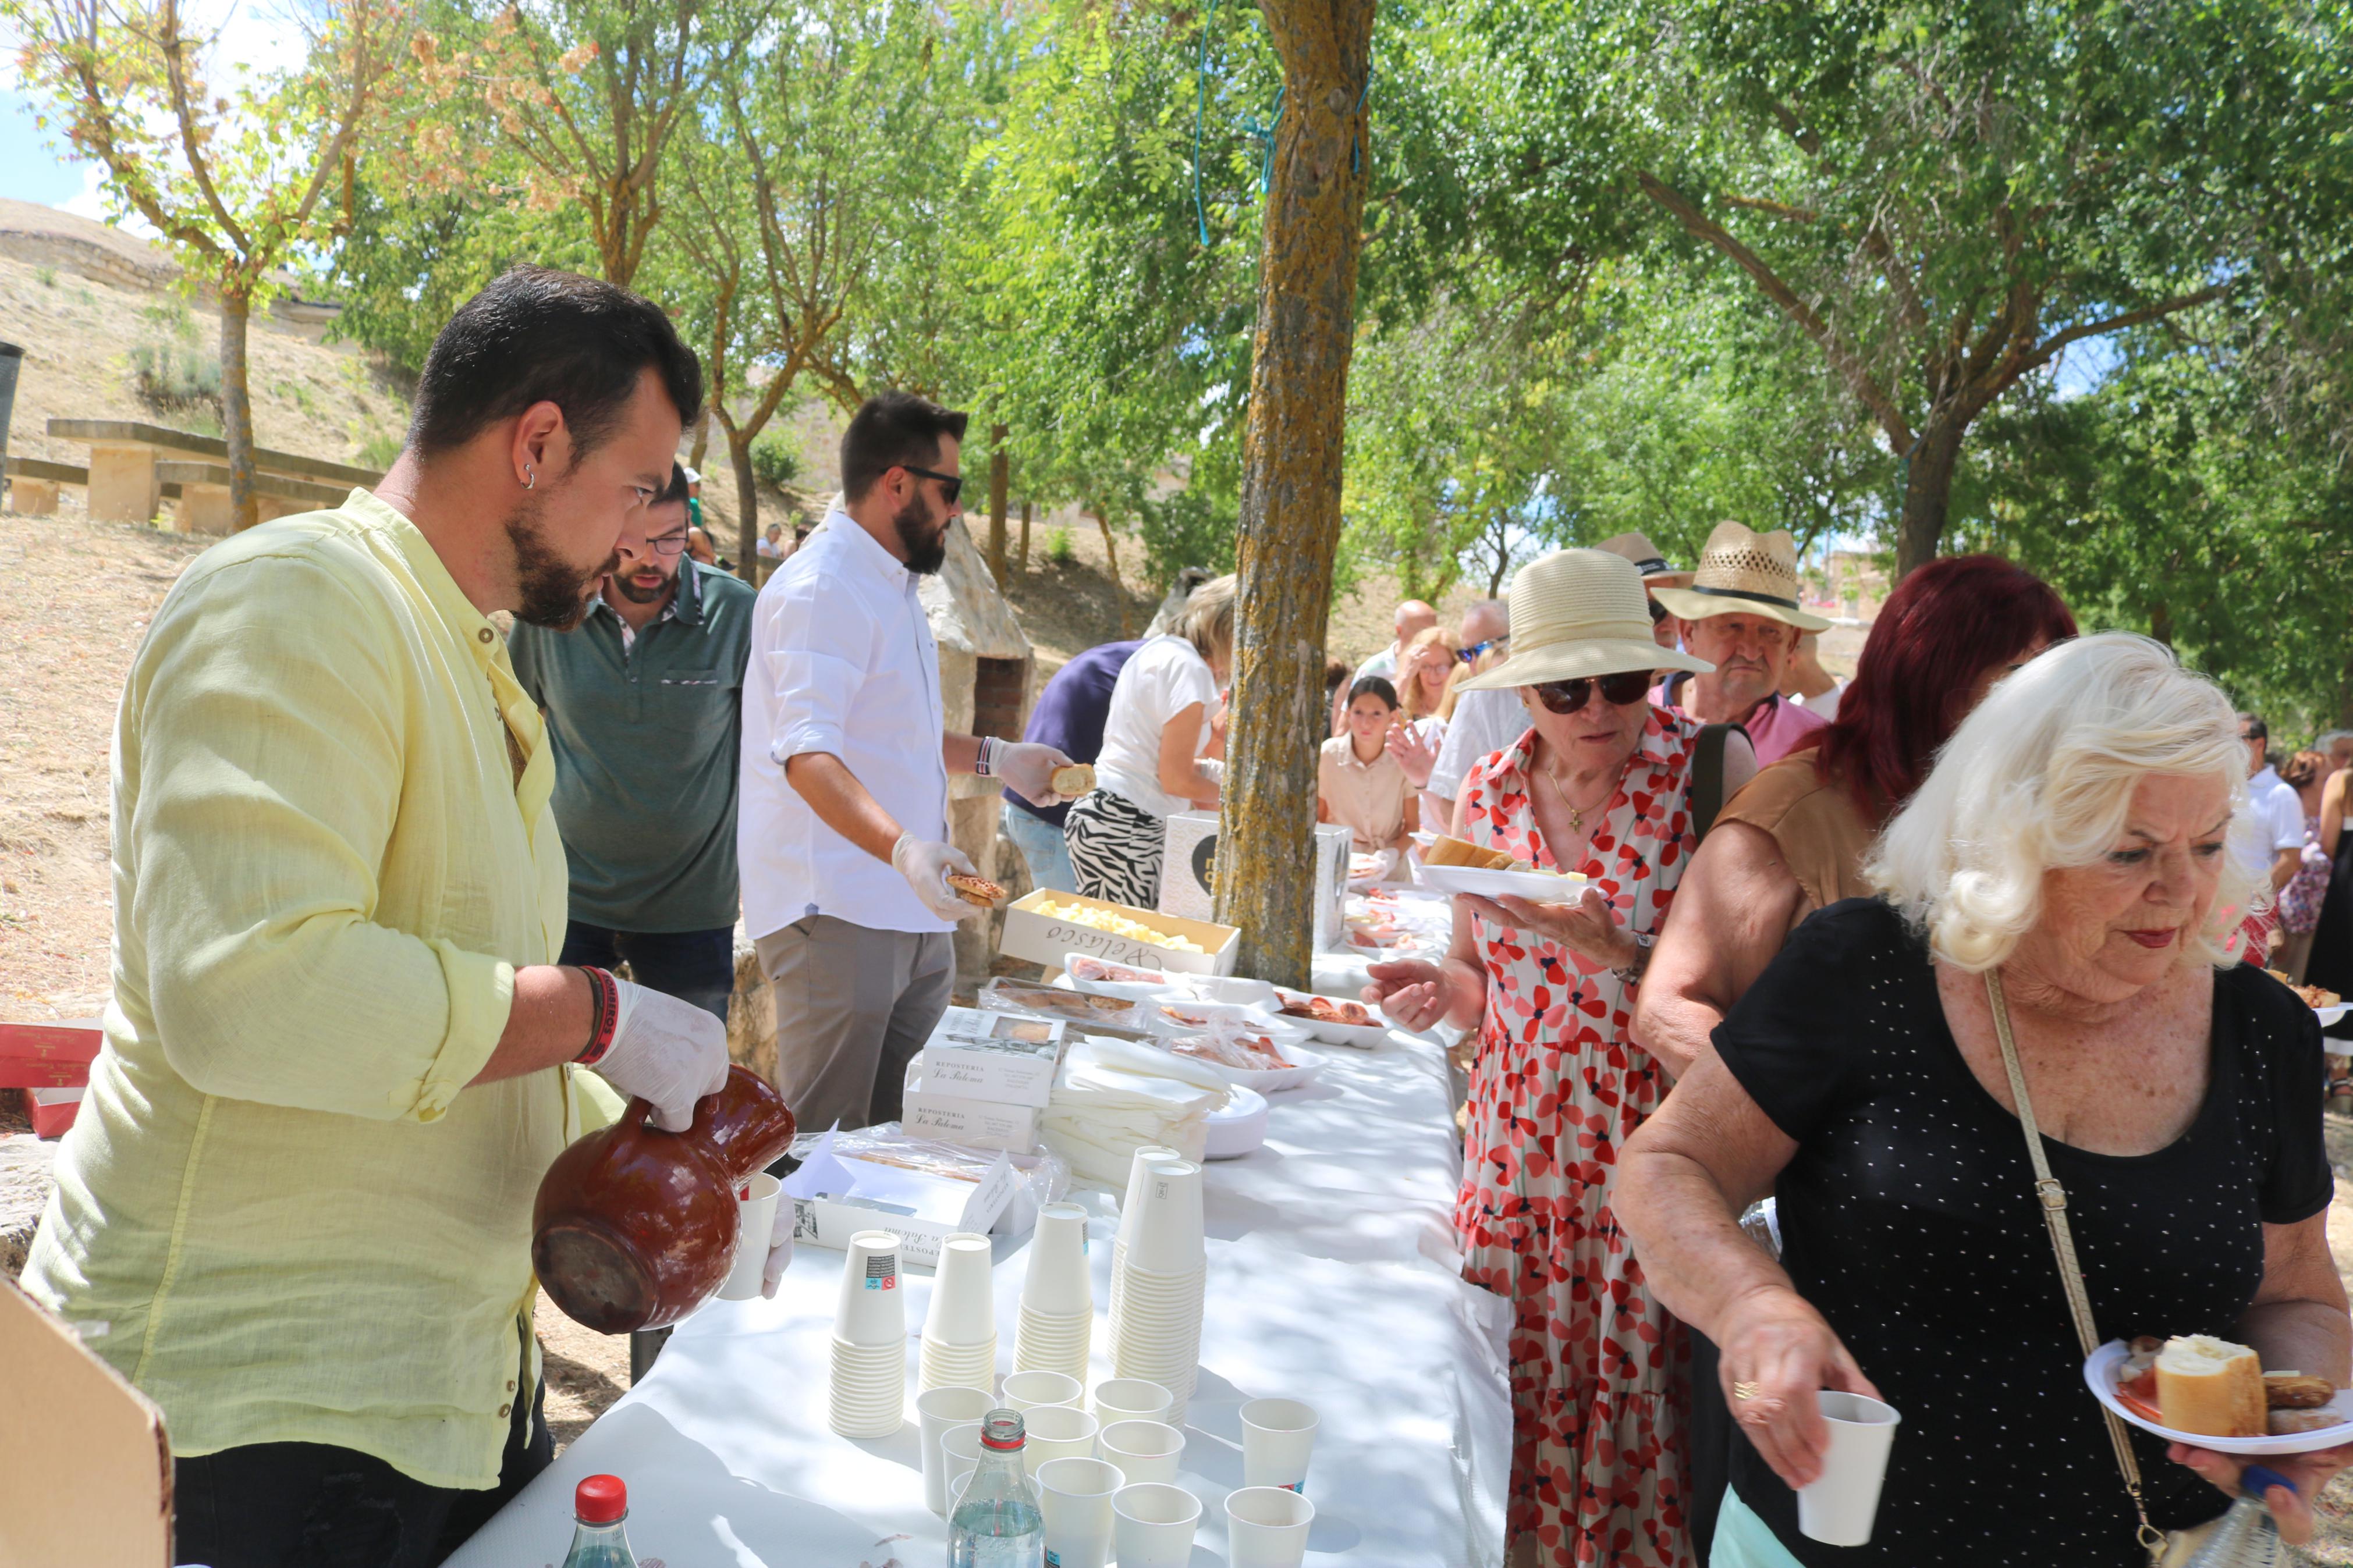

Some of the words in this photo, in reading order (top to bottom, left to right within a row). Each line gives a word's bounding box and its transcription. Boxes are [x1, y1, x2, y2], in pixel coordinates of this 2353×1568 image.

[1046, 926, 1162, 971] Velasco
[603, 974, 616, 1034] BOMBEROS
[935, 1061, 985, 1072] REPOSTERIA
[933, 1068, 947, 1078] La
[949, 1071, 984, 1083] Paloma
[918, 1107, 965, 1119] REPOSTERIA
[915, 1114, 928, 1125] La
[931, 1118, 964, 1130] Paloma
[883, 1226, 927, 1245] Paloma
[900, 1244, 941, 1257] EPOSTE
